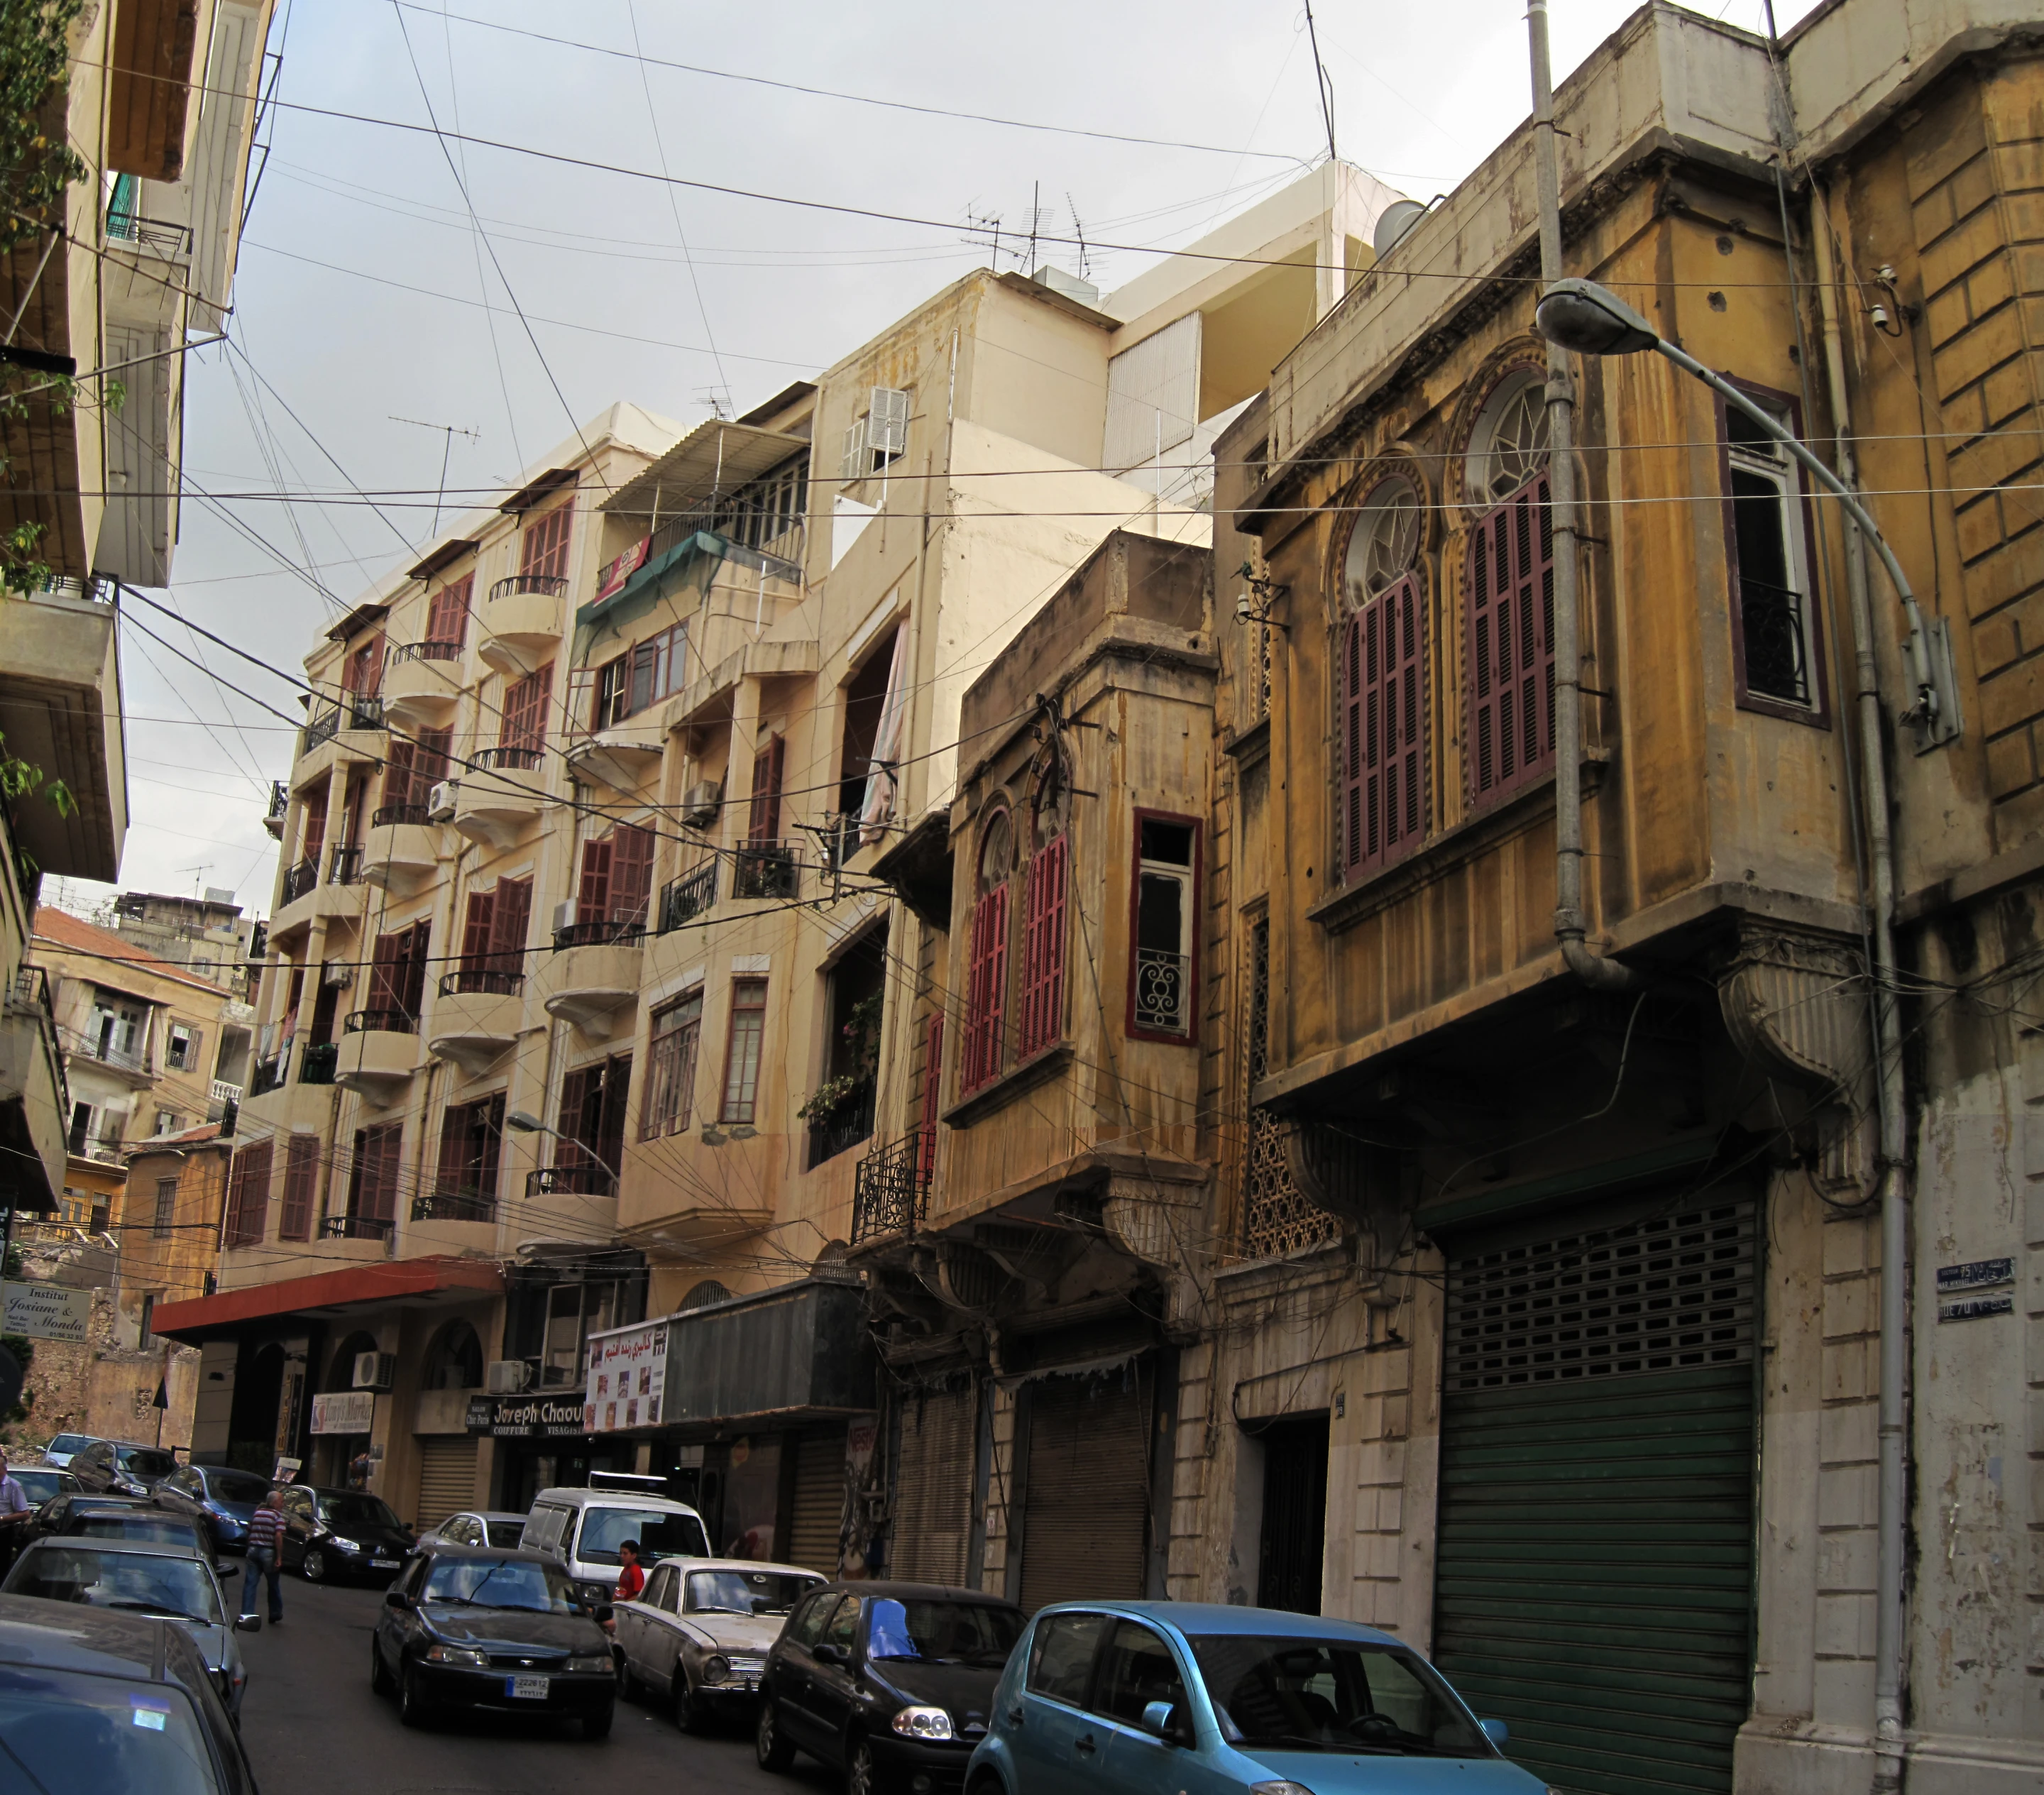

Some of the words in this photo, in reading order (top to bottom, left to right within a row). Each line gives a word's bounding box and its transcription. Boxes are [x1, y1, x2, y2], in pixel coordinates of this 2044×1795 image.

[29, 1288, 69, 1301] Institut
[4, 1297, 58, 1314] Josiane
[62, 1307, 72, 1317] &
[34, 1315, 83, 1332] Monda
[494, 1402, 537, 1426] Joseph
[547, 1426, 584, 1434] VISAGIST
